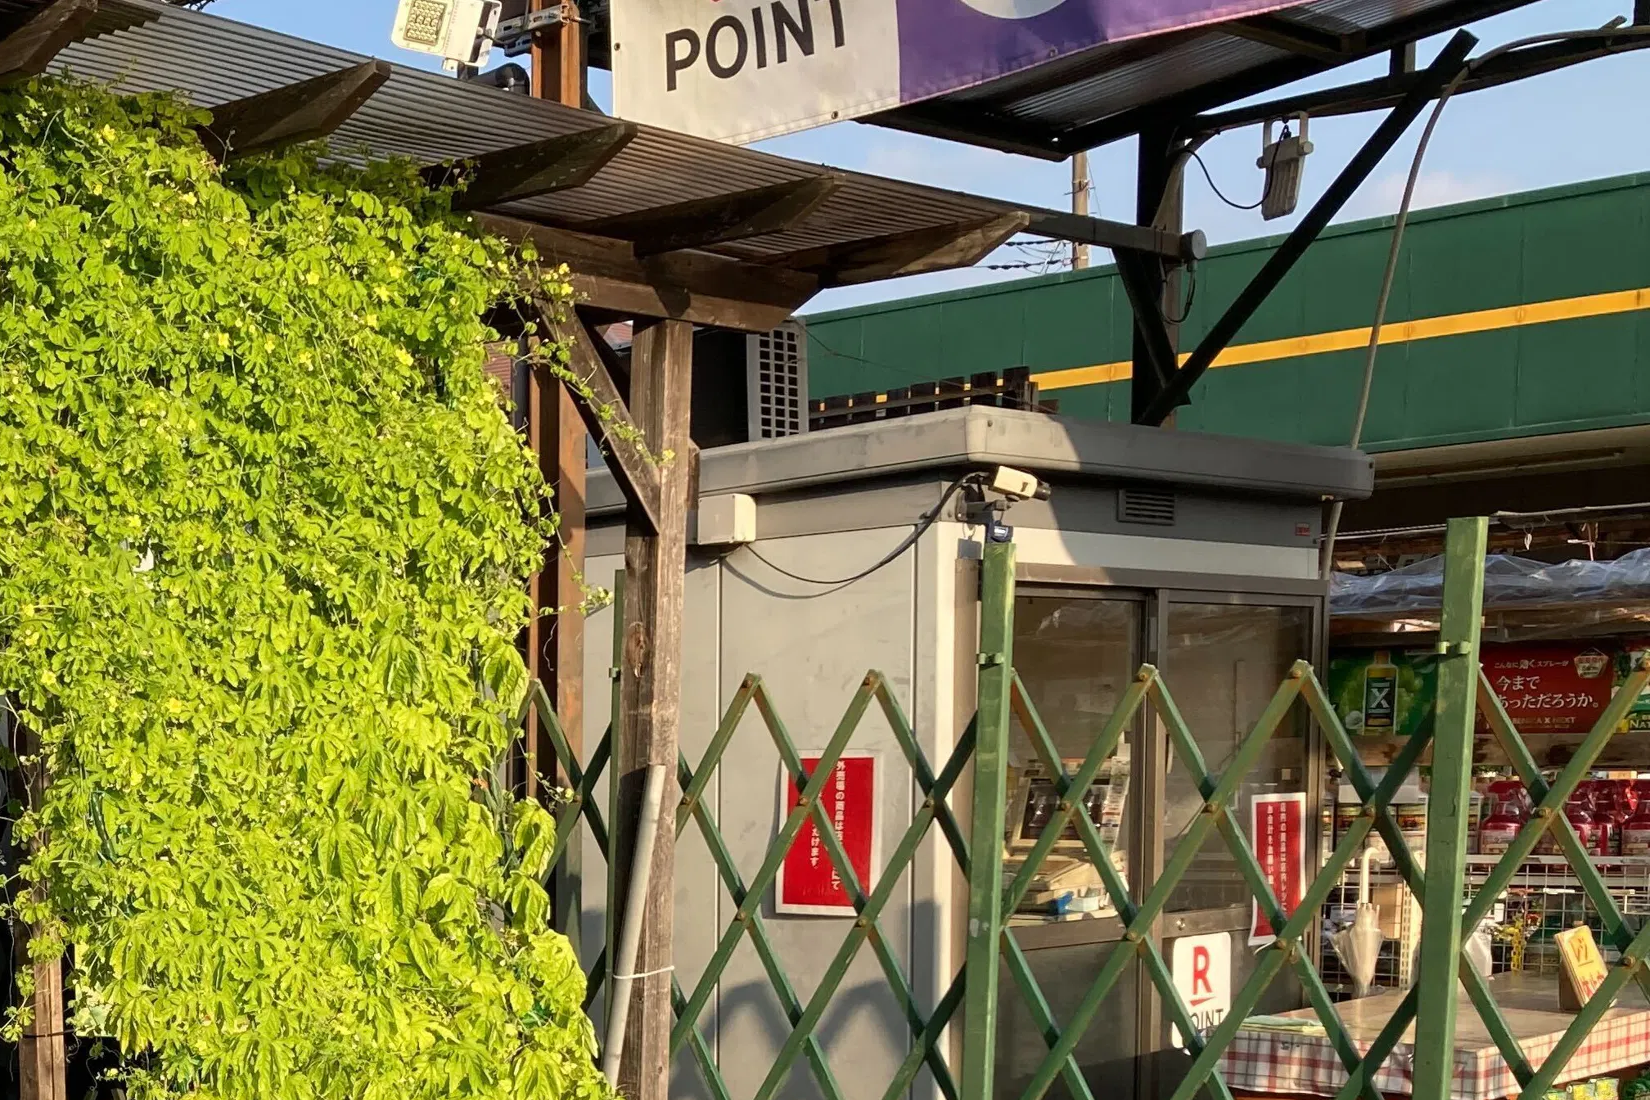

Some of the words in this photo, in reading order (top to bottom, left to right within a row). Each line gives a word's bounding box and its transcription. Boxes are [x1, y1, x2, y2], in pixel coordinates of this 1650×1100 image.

[665, 0, 846, 92] POINT
[1496, 675, 1541, 691] 今まで
[1498, 692, 1599, 709] あっただろうか。
[1192, 945, 1213, 995] R
